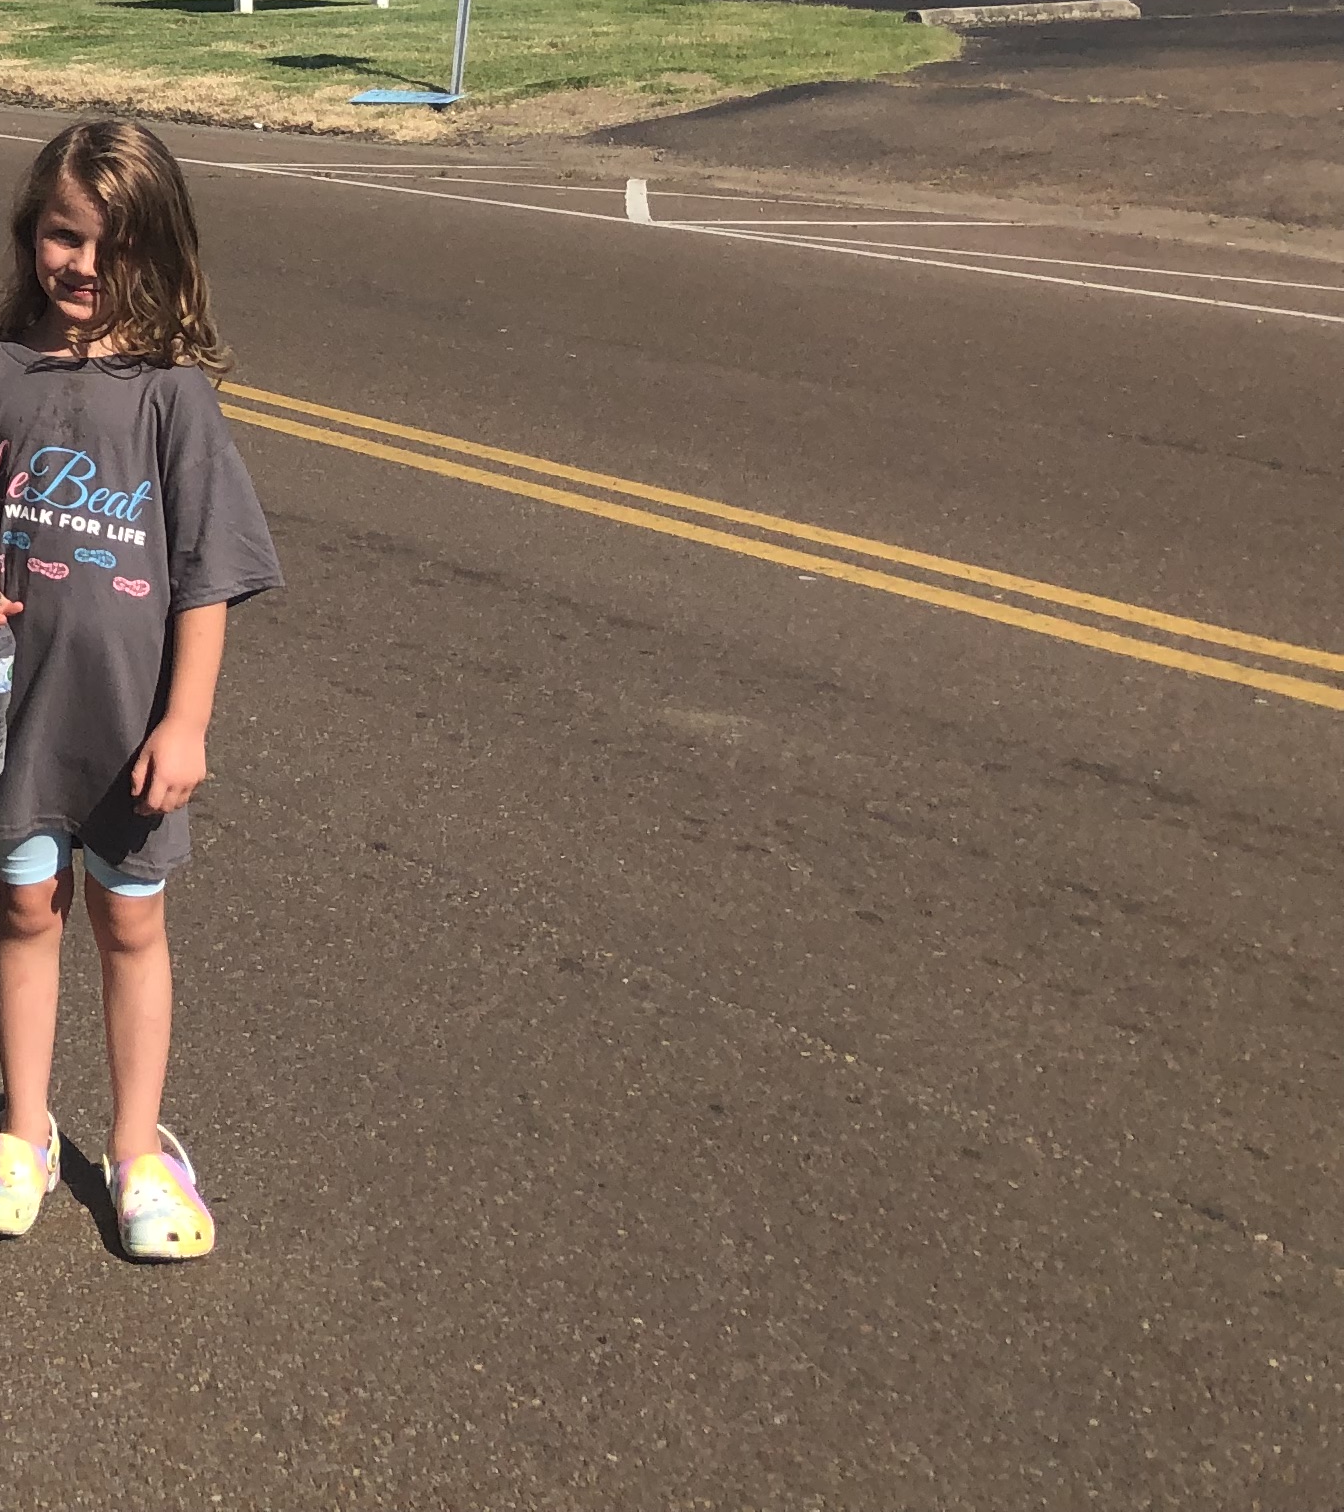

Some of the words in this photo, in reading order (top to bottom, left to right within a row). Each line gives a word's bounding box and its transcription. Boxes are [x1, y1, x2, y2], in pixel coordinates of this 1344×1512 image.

[4, 503, 54, 526] WALK
[58, 513, 100, 536] FOR
[106, 523, 147, 547] LIFE
